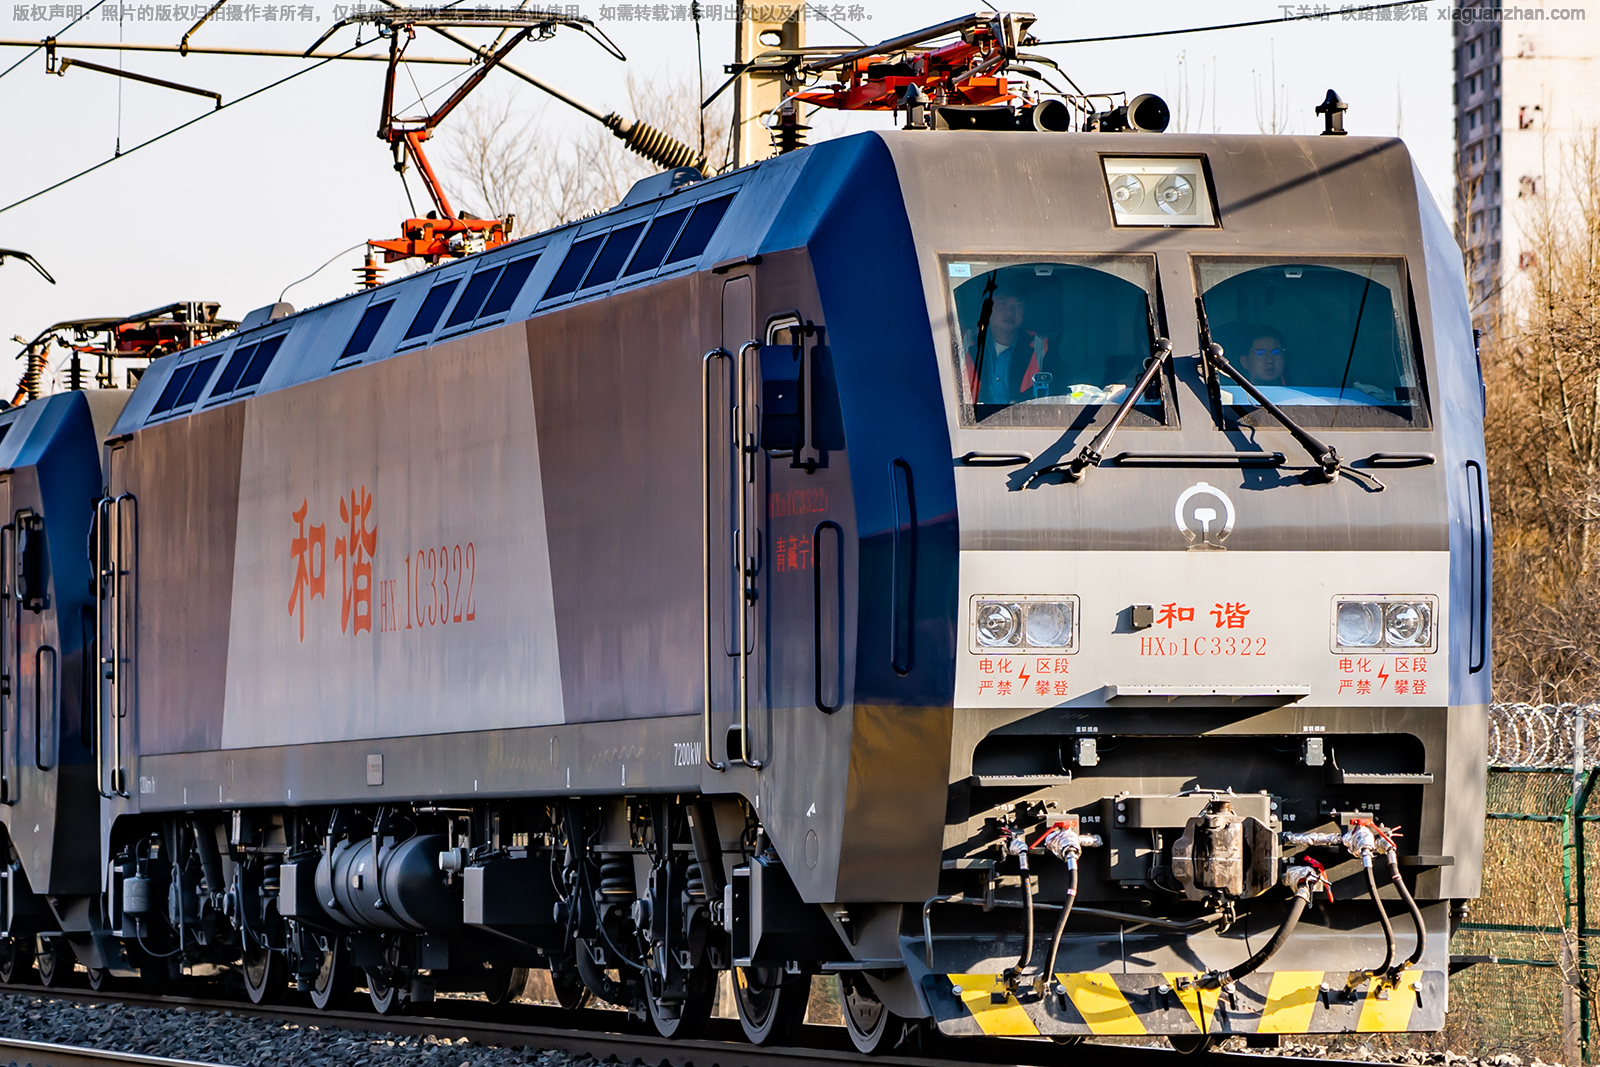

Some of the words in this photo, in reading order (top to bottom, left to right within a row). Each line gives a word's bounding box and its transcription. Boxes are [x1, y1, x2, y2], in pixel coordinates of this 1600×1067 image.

[288, 484, 377, 642] 和谐
[776, 534, 821, 572] 青藏宁
[1156, 602, 1250, 629] 和谐
[979, 657, 1013, 674] 电化
[1036, 657, 1069, 674] 区段
[1339, 657, 1372, 673] 电化
[1395, 657, 1427, 673] 区段
[978, 680, 1012, 696] 严禁
[1035, 680, 1068, 696] 攀登
[1338, 679, 1371, 695] 严禁
[1394, 679, 1427, 695] 攀登
[673, 742, 702, 767] 7200kW
